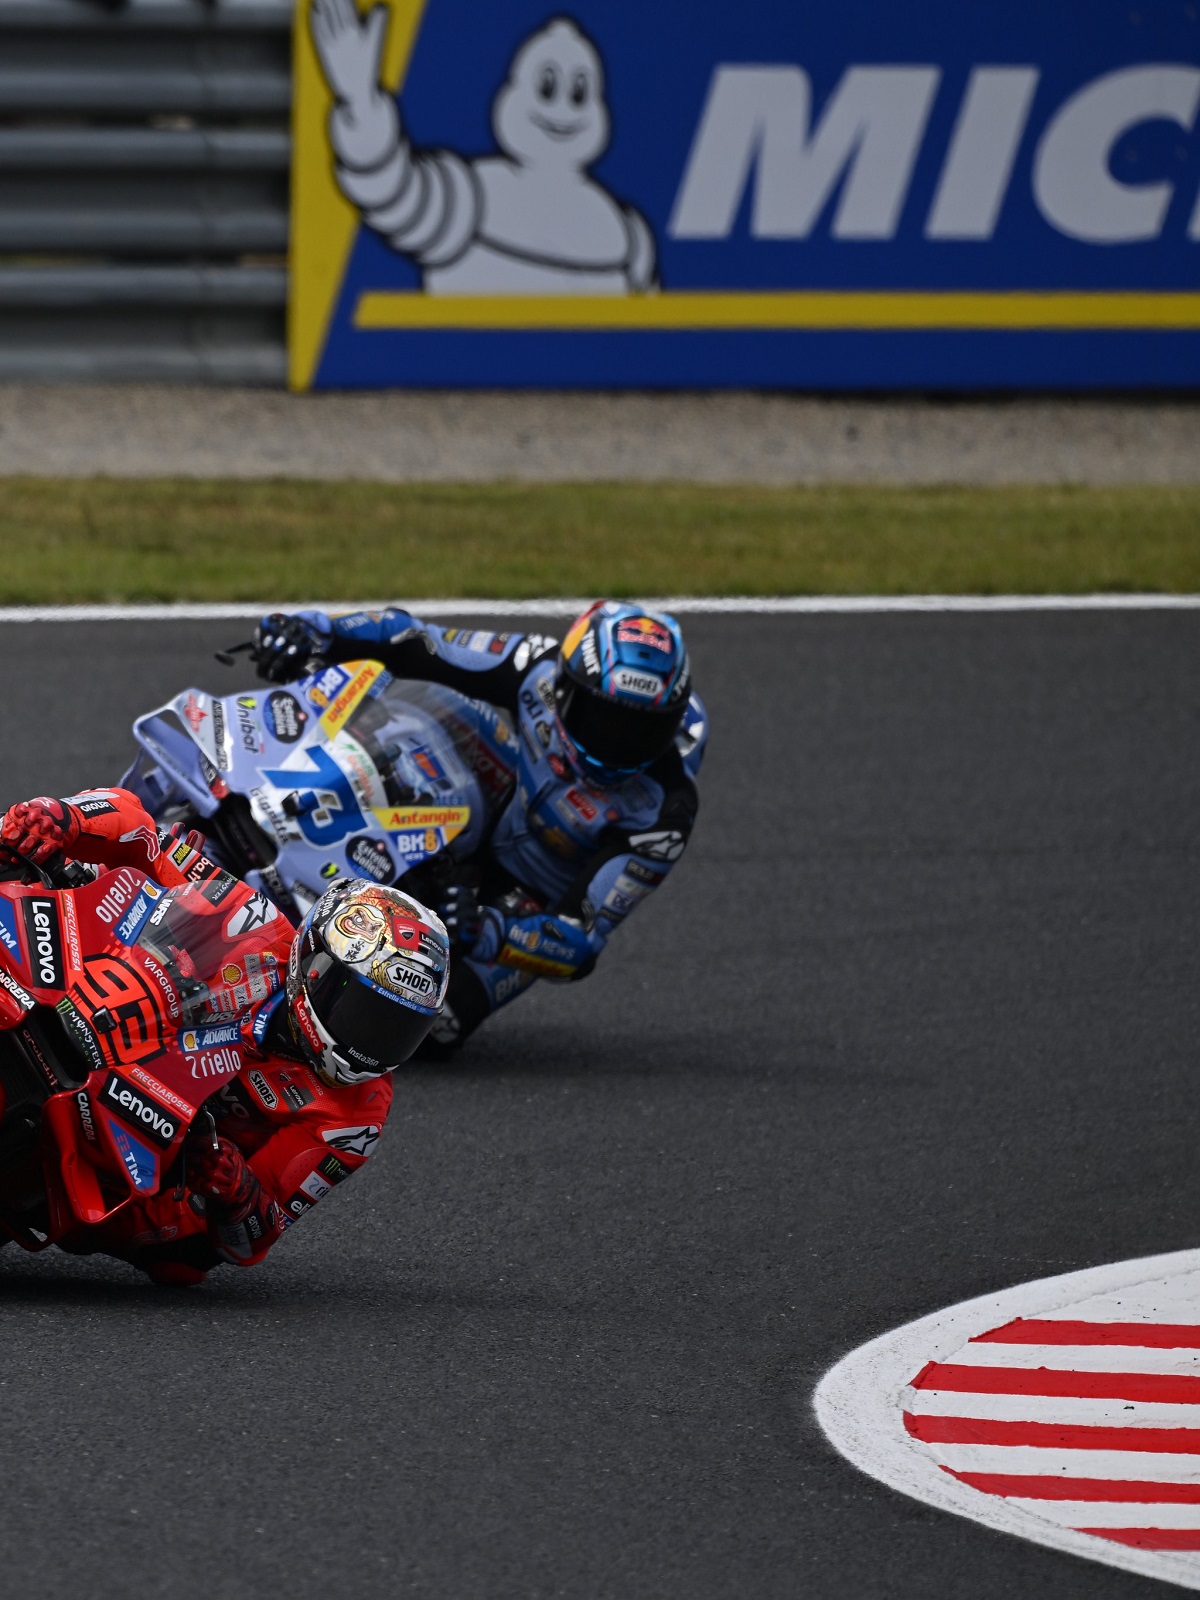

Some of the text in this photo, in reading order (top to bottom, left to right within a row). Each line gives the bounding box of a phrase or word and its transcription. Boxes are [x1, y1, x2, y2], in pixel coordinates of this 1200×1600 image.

[666, 63, 1200, 245] MIC
[621, 674, 658, 693] SHOEI
[260, 744, 369, 848] 73
[388, 809, 462, 826] Antangin
[396, 828, 438, 854] BK8
[188, 856, 215, 884] ba.it
[119, 894, 149, 941] ADVANCE
[150, 898, 174, 927] WRS
[32, 901, 56, 984] Lenovo
[64, 893, 82, 972] FRECCIAROSSA
[421, 933, 444, 954] Lenovo
[143, 957, 180, 1019] VARGROUP
[377, 987, 400, 1003] Estrella
[393, 966, 431, 994] SHOEI
[73, 957, 161, 1065] 93
[254, 1013, 268, 1035] TIM
[296, 1000, 319, 1048] Lenovo
[68, 1010, 102, 1069] MONSTER
[202, 1027, 238, 1046] ADVANCE
[22, 1029, 59, 1087] aruba.it
[200, 1047, 242, 1078] riello
[347, 1046, 380, 1067] Insta360
[131, 1067, 194, 1117] FRECCIAROSSA
[251, 1074, 276, 1106] SHOEI
[289, 1085, 304, 1106] Lenovo
[77, 1092, 97, 1141] CARRERA
[108, 1077, 175, 1140] Lenovo
[125, 1152, 142, 1186] TIM
